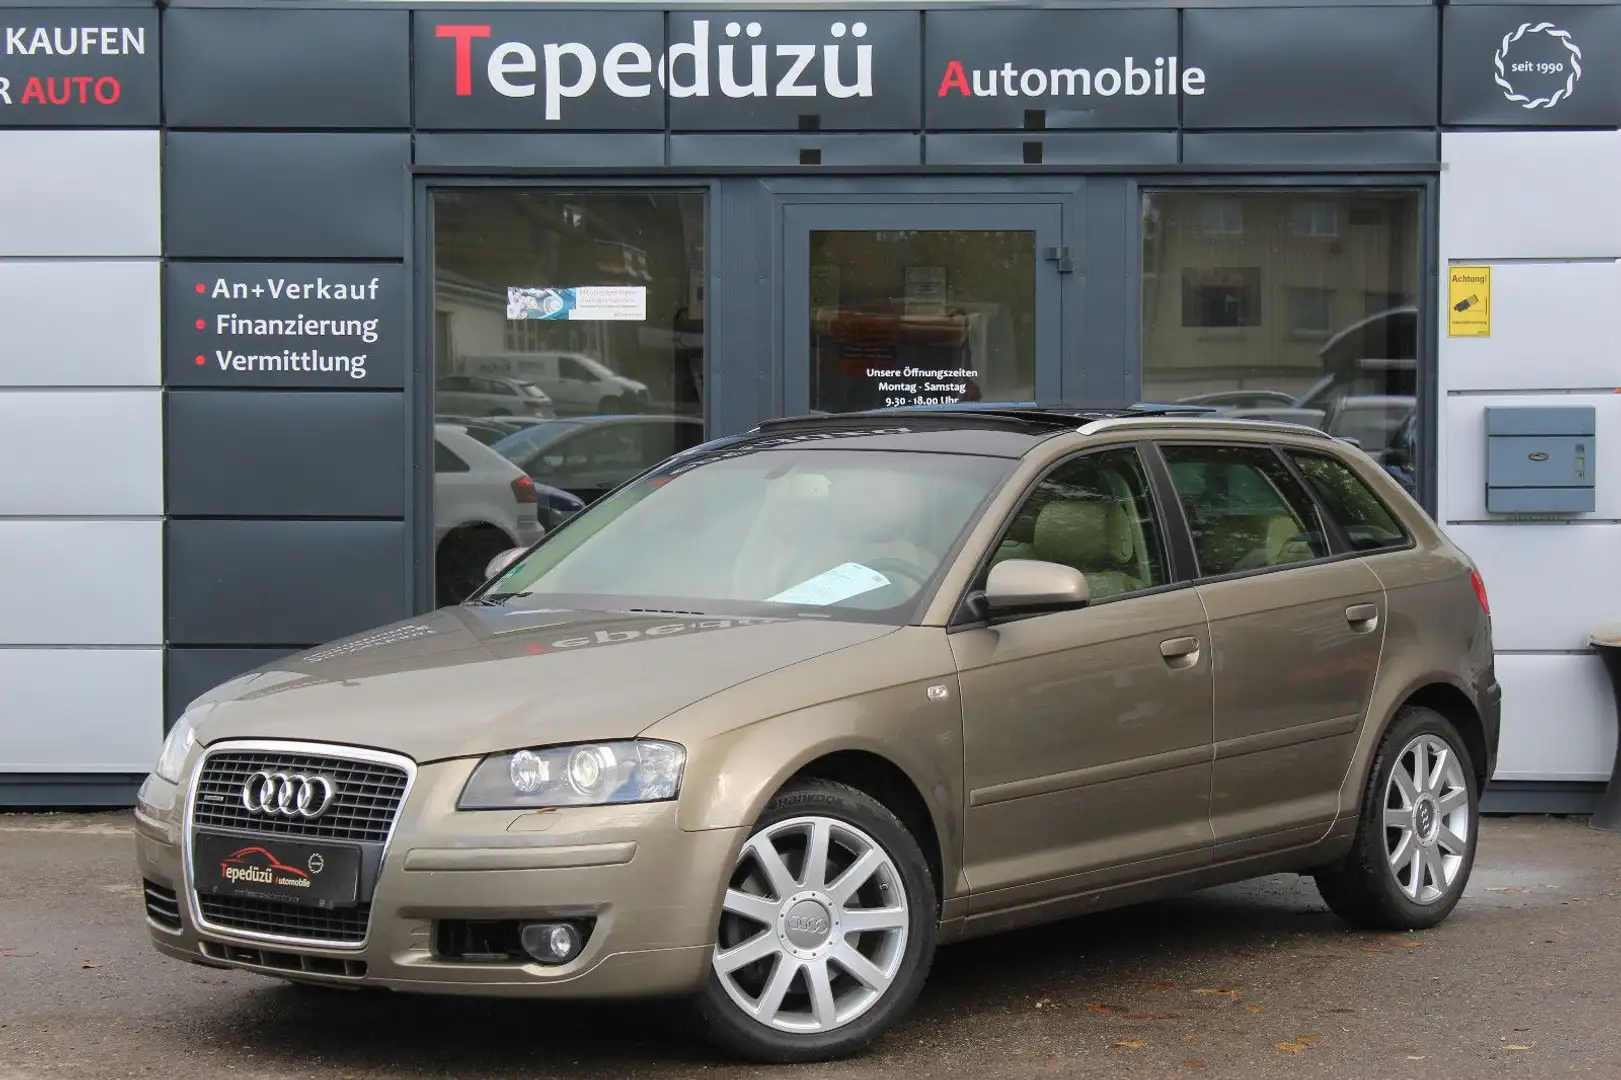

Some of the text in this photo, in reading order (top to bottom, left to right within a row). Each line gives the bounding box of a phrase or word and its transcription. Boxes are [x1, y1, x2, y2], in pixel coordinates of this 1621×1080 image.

[6, 27, 145, 55] KAUFEN
[434, 19, 1206, 120] Tepedüzü Automobile
[1511, 61, 1563, 74] seit 1990
[21, 76, 121, 105] AUTO
[211, 277, 379, 300] An+Verkauf
[216, 313, 379, 343] Finanzierung
[215, 350, 367, 379] Vermittlung
[866, 366, 978, 380] Unsere Öffnungszeiten
[878, 382, 917, 394] Montag
[924, 382, 966, 394] Samstag
[885, 397, 906, 407] 9.30
[913, 396, 938, 405] 18.00
[940, 396, 959, 405] Uhr
[220, 862, 310, 888] Tepedüzü Automobile
